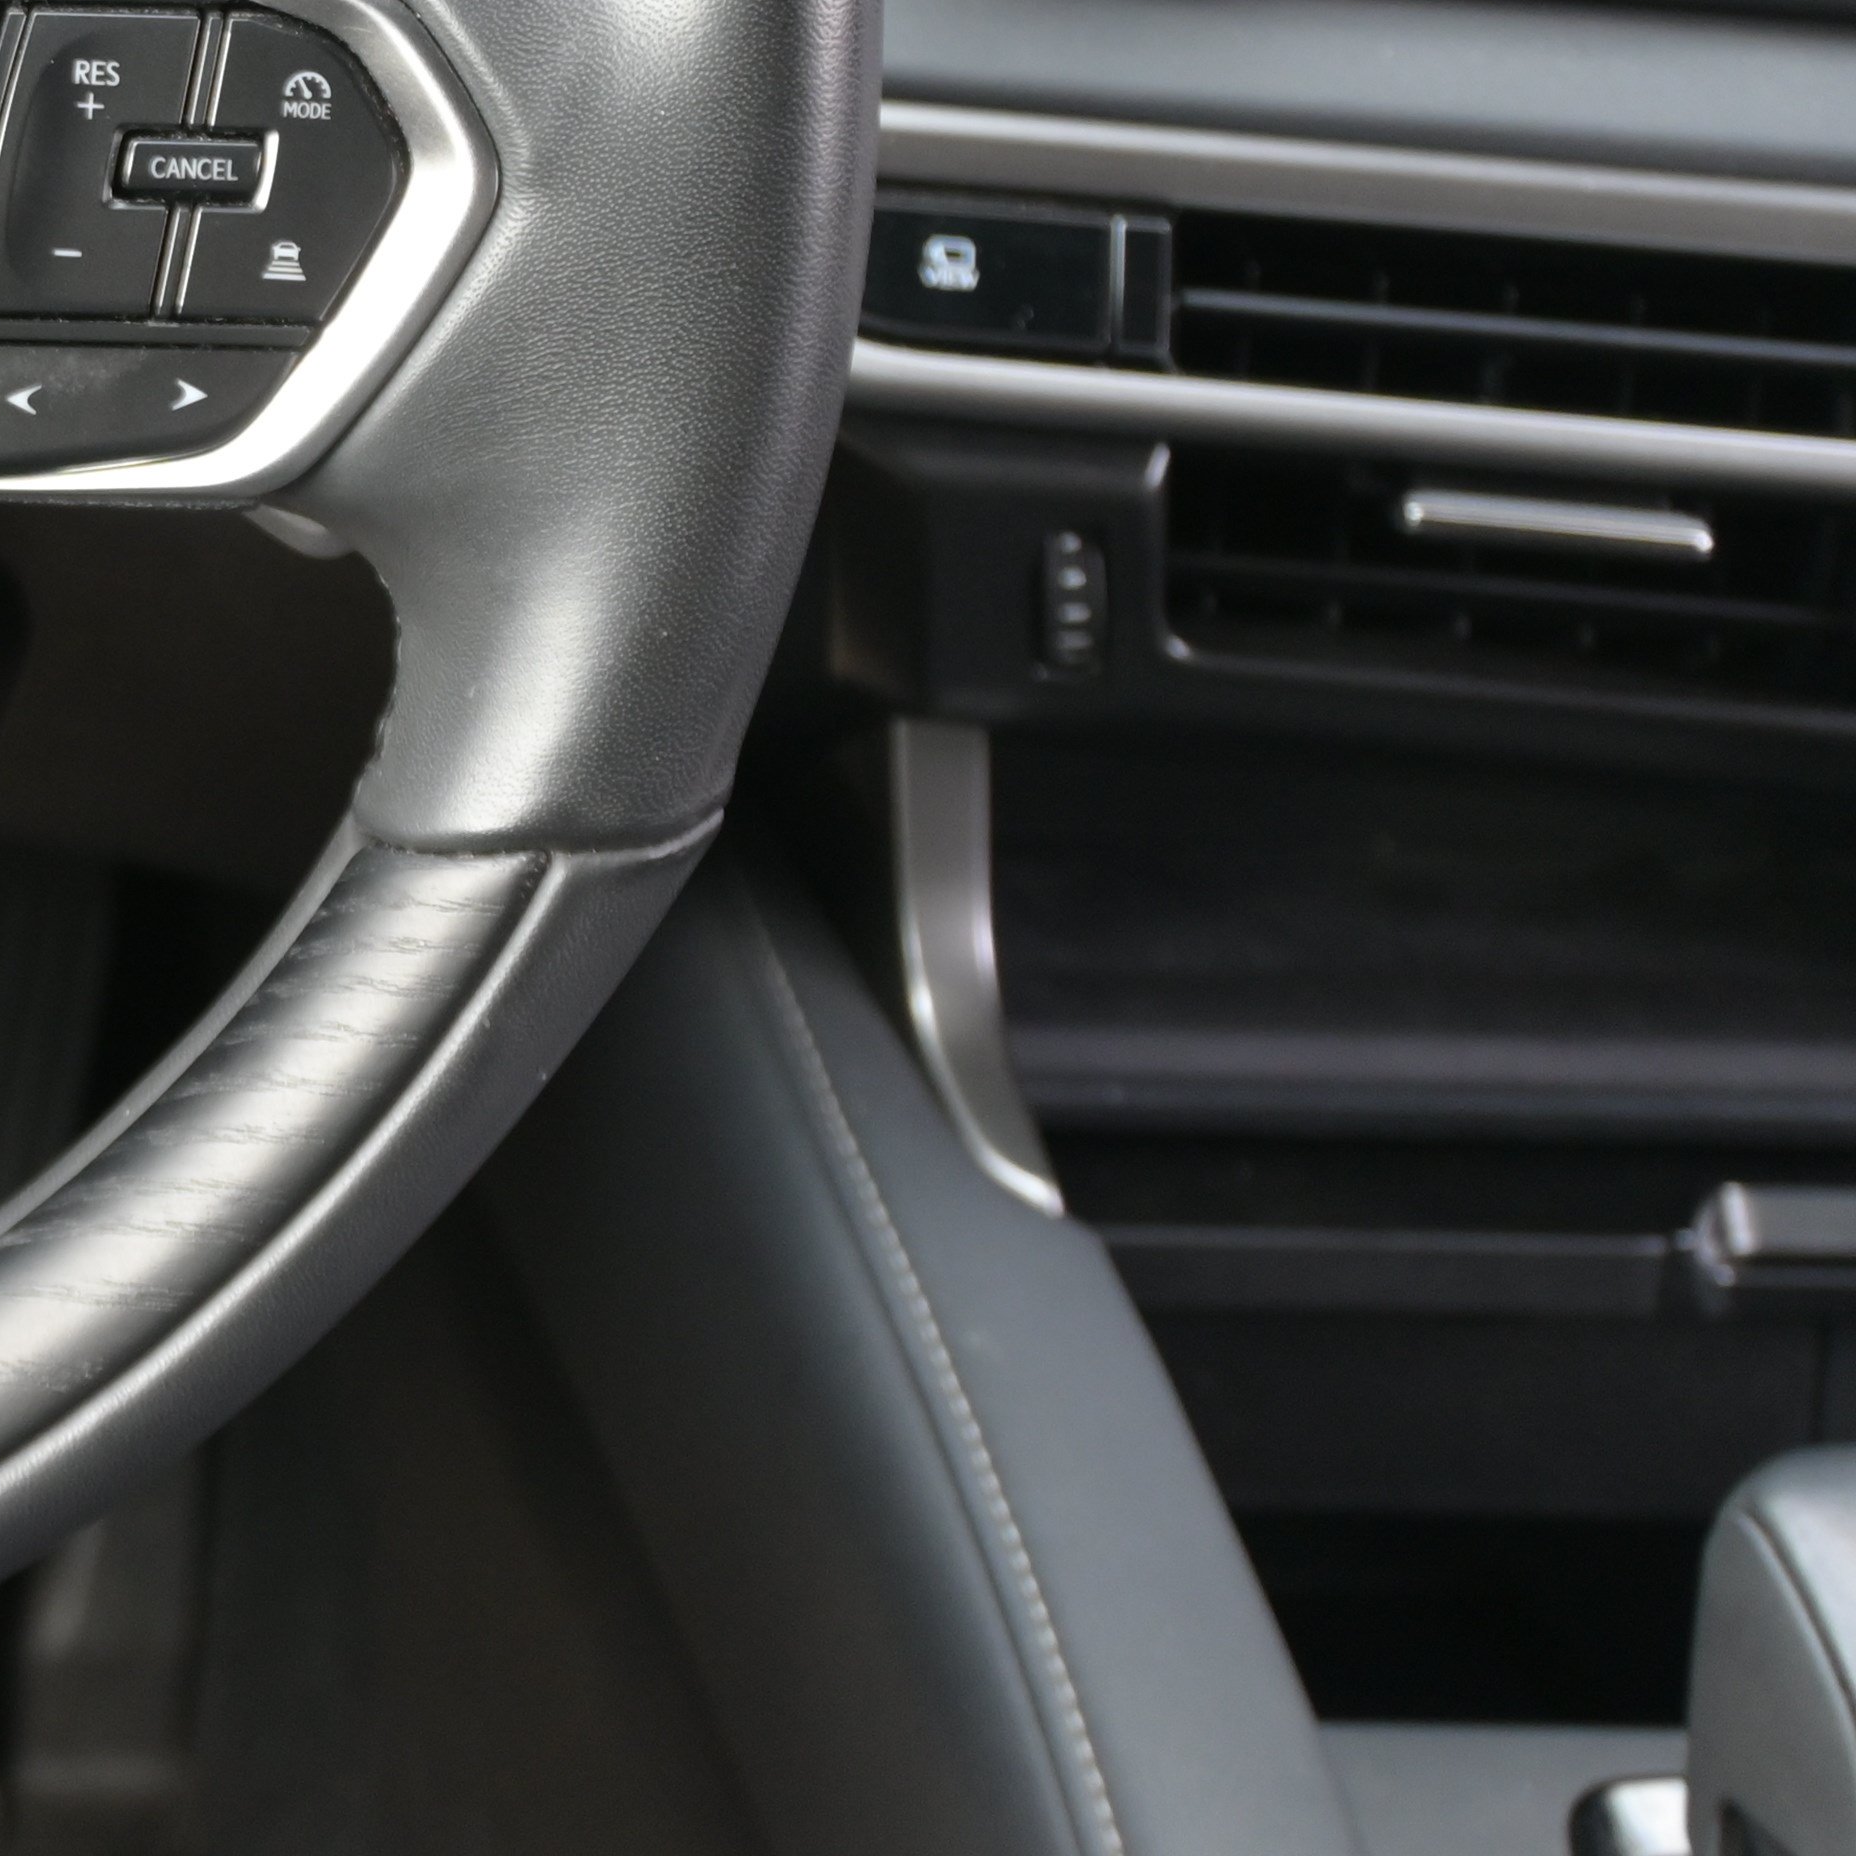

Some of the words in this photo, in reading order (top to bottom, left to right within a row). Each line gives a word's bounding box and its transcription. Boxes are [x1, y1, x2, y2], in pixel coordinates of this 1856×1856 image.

[74, 61, 121, 87] RES
[283, 101, 332, 121] MODE
[149, 156, 238, 182] CANCEL
